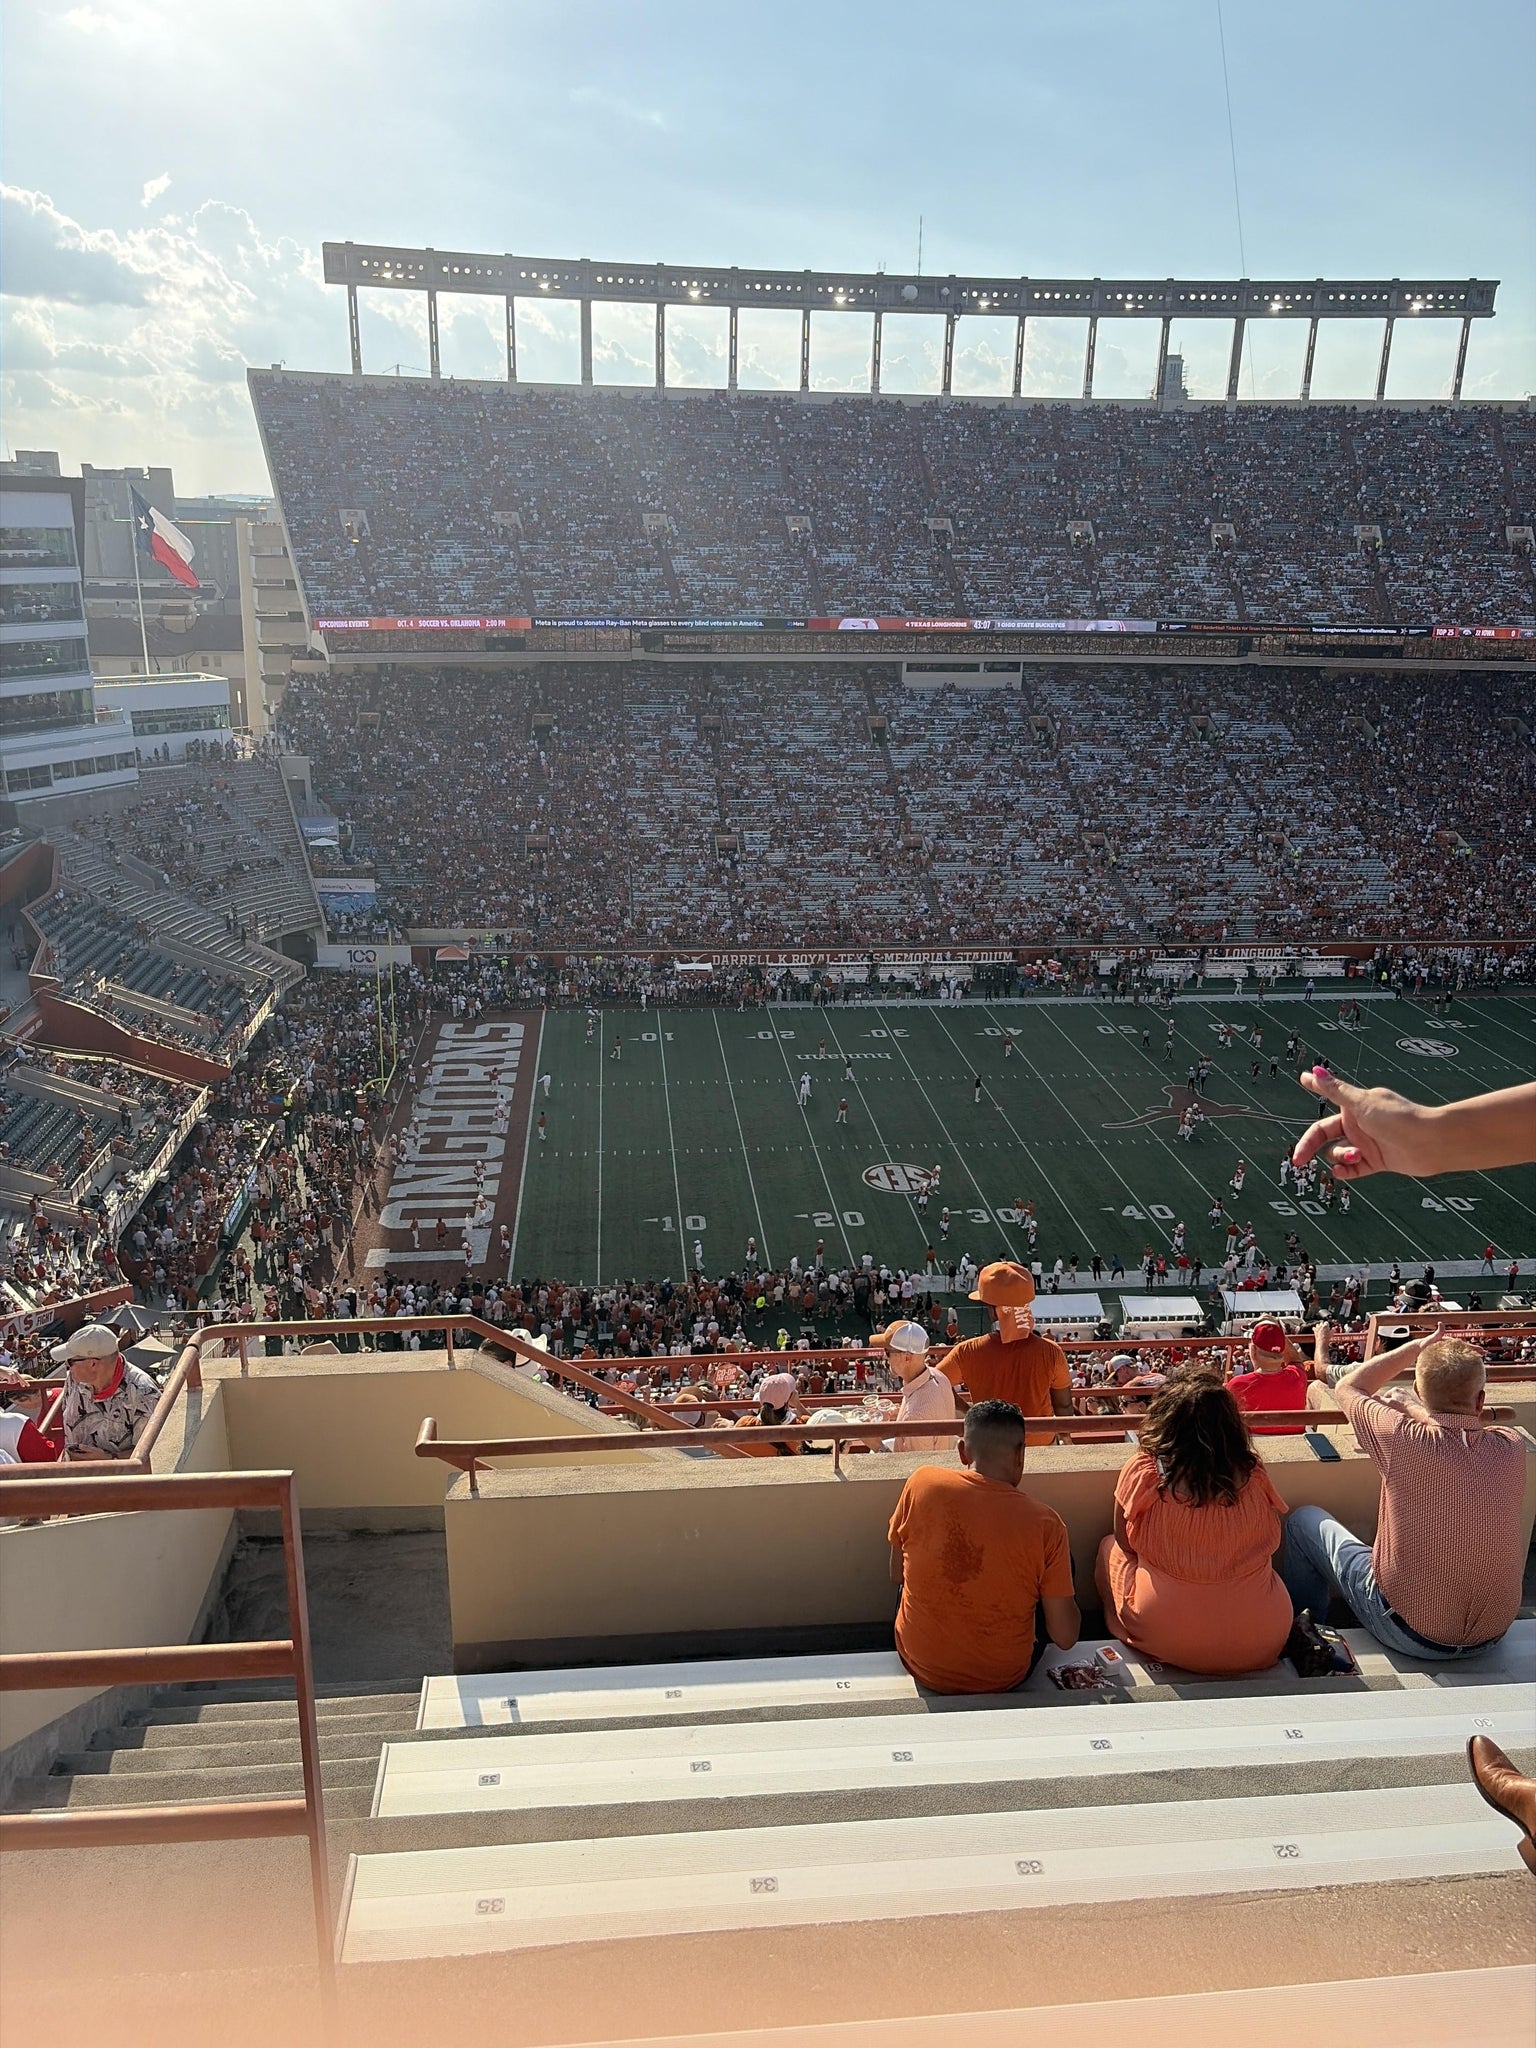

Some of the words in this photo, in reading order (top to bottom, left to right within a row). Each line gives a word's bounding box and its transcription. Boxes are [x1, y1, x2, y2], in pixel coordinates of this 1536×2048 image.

[348, 620, 369, 628] EVENTS
[397, 620, 409, 628] OCT.
[410, 620, 414, 628] 4
[418, 620, 439, 628] SOCCER
[440, 620, 450, 628] VS.
[450, 619, 481, 628] OKLAHOMA
[486, 619, 497, 628] 2:00
[498, 619, 506, 628] PM
[558, 620, 576, 628] proud
[606, 620, 631, 628] Ray-Ban
[648, 620, 670, 628] glasses
[974, 620, 991, 630] 43:07
[346, 949, 377, 963] 100
[713, 954, 774, 966] DARRELL
[778, 954, 789, 965] K
[956, 951, 1013, 963] STADIUM
[1097, 1024, 1138, 1035] 50
[1425, 1020, 1461, 1030] 20
[642, 1032, 675, 1042] 10
[758, 1030, 796, 1041] 20
[871, 1028, 911, 1039] 30
[984, 1026, 1023, 1037] 40
[364, 1022, 525, 1268] LONGHORNS
[1268, 1200, 1328, 1216] 50
[1420, 1197, 1475, 1213] 40
[967, 1207, 1021, 1223] 30
[1121, 1204, 1176, 1221] 40
[661, 1215, 707, 1232] 10
[812, 1210, 866, 1227] 20
[717, 1368, 737, 1377] CO-OP
[1147, 1663, 1161, 1672] 31
[836, 1681, 851, 1689] 33
[666, 1690, 682, 1698] 34
[1474, 1718, 1492, 1728] 30
[1284, 1729, 1303, 1739] 31
[1090, 1739, 1110, 1750] 32
[893, 1751, 912, 1761] 33
[691, 1761, 711, 1772] 34
[480, 1775, 498, 1785] 35
[1273, 1844, 1299, 1858] 32
[1016, 1861, 1042, 1875] 33
[750, 1878, 776, 1892] 34
[477, 1899, 503, 1913] 35
